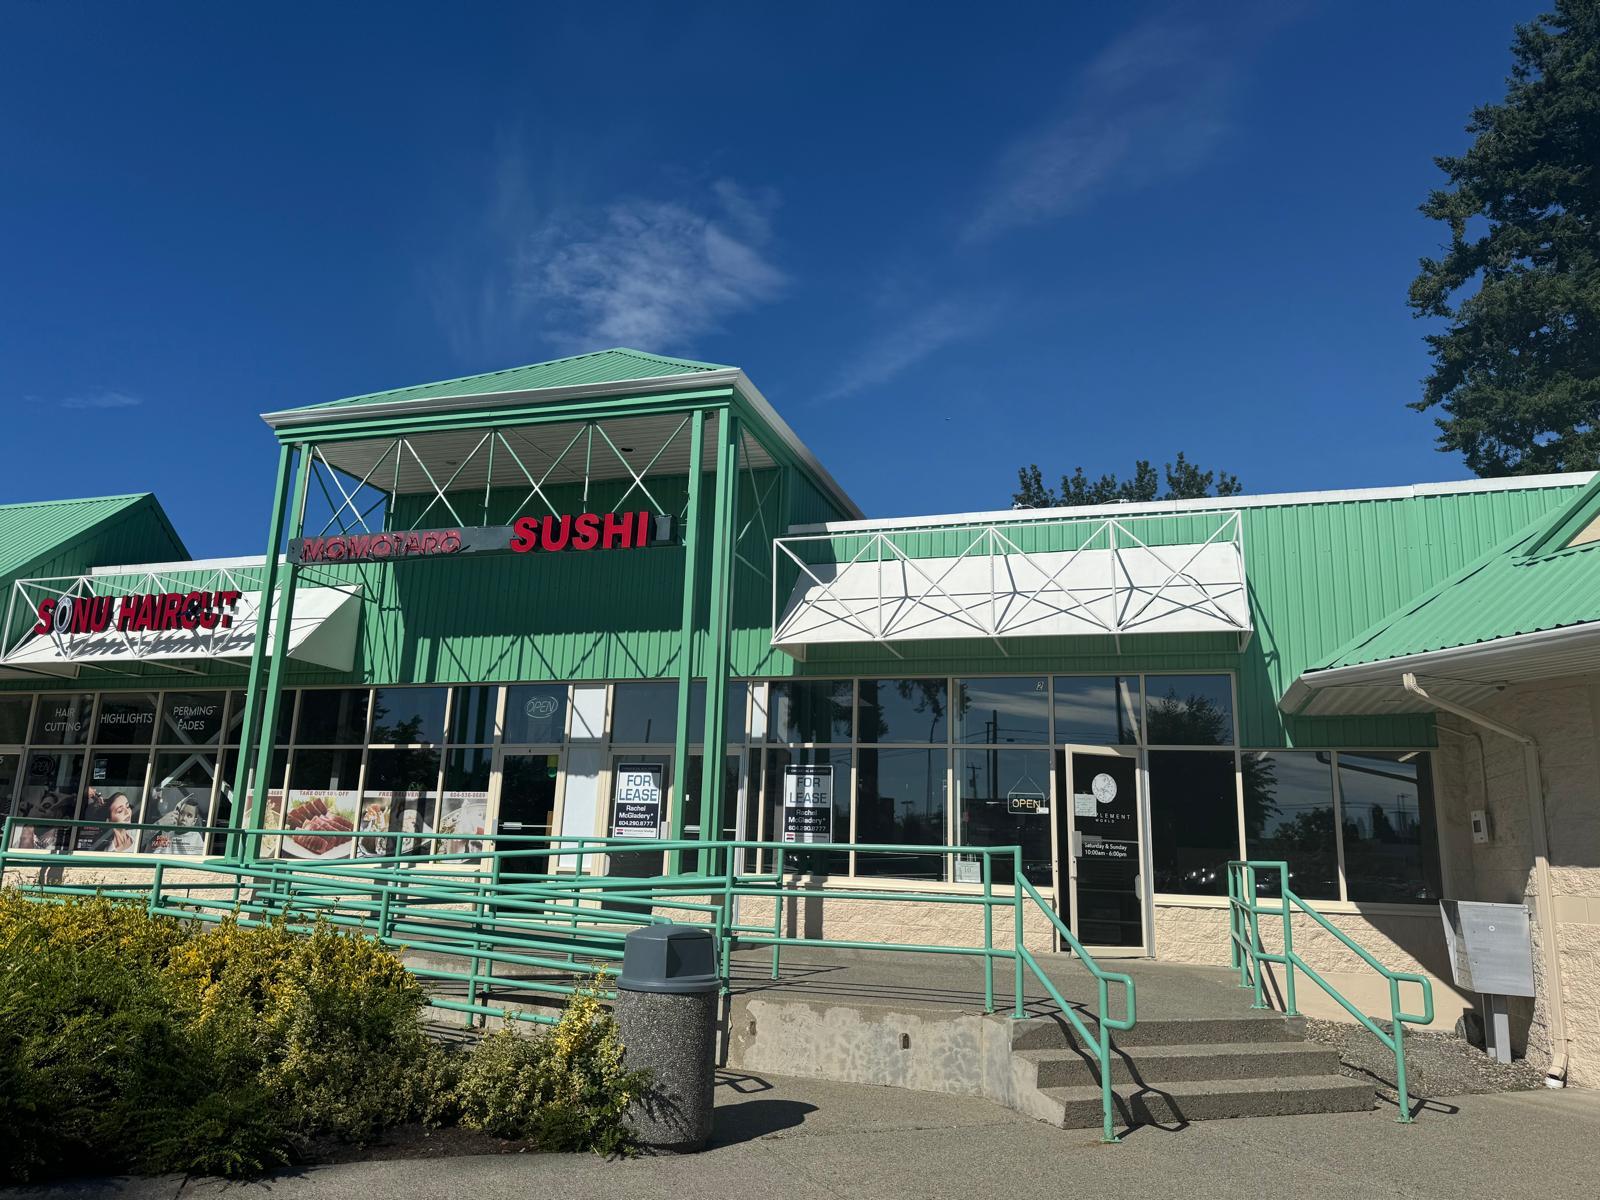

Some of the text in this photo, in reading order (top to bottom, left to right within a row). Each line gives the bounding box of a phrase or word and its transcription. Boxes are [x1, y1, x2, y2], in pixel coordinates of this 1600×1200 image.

[300, 511, 650, 562] MOMOTARO SUSHI
[33, 591, 241, 635] SONU HAIRCUT
[55, 707, 76, 718] HAIR
[173, 705, 214, 717] PERMING
[526, 700, 555, 713] OPEN
[101, 712, 153, 724] HIGHLIGHTS
[44, 722, 81, 732] CUTTING
[177, 720, 205, 731] FADES
[627, 774, 651, 786] FOR
[797, 777, 821, 788] FOR
[619, 789, 657, 801] LEASE
[789, 792, 827, 804] LEASE
[1012, 798, 1041, 809] OPEN
[1084, 842, 1104, 850] Saturday
[1110, 843, 1127, 851] Sunday
